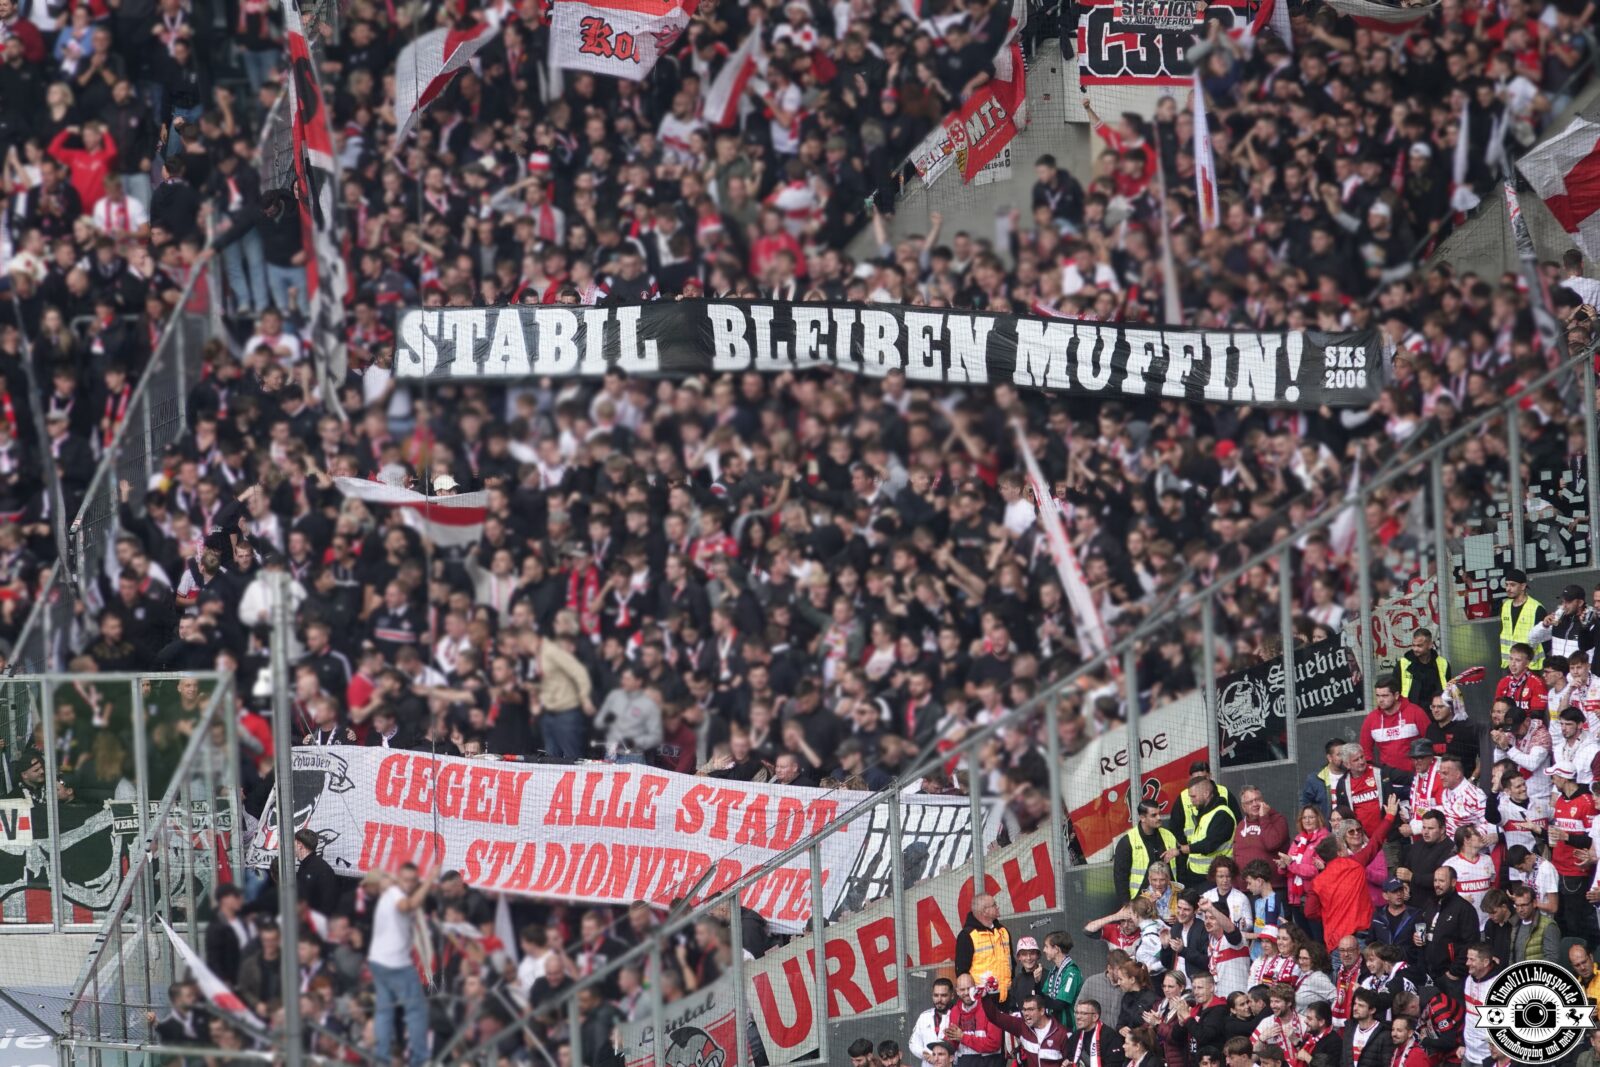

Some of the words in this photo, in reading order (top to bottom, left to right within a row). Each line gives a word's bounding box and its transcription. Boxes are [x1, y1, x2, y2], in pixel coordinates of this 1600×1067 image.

[1121, 0, 1198, 16] SEKTION
[396, 305, 659, 377] STABIL
[707, 304, 995, 384] BLEIBEN
[1013, 318, 1304, 402] MUFFIN!
[1325, 346, 1366, 368] SKS
[1325, 369, 1366, 388] 2006
[292, 754, 331, 769] chwaben
[375, 753, 533, 826] GEGEN
[543, 771, 669, 830] ALLE
[358, 821, 446, 878] UND
